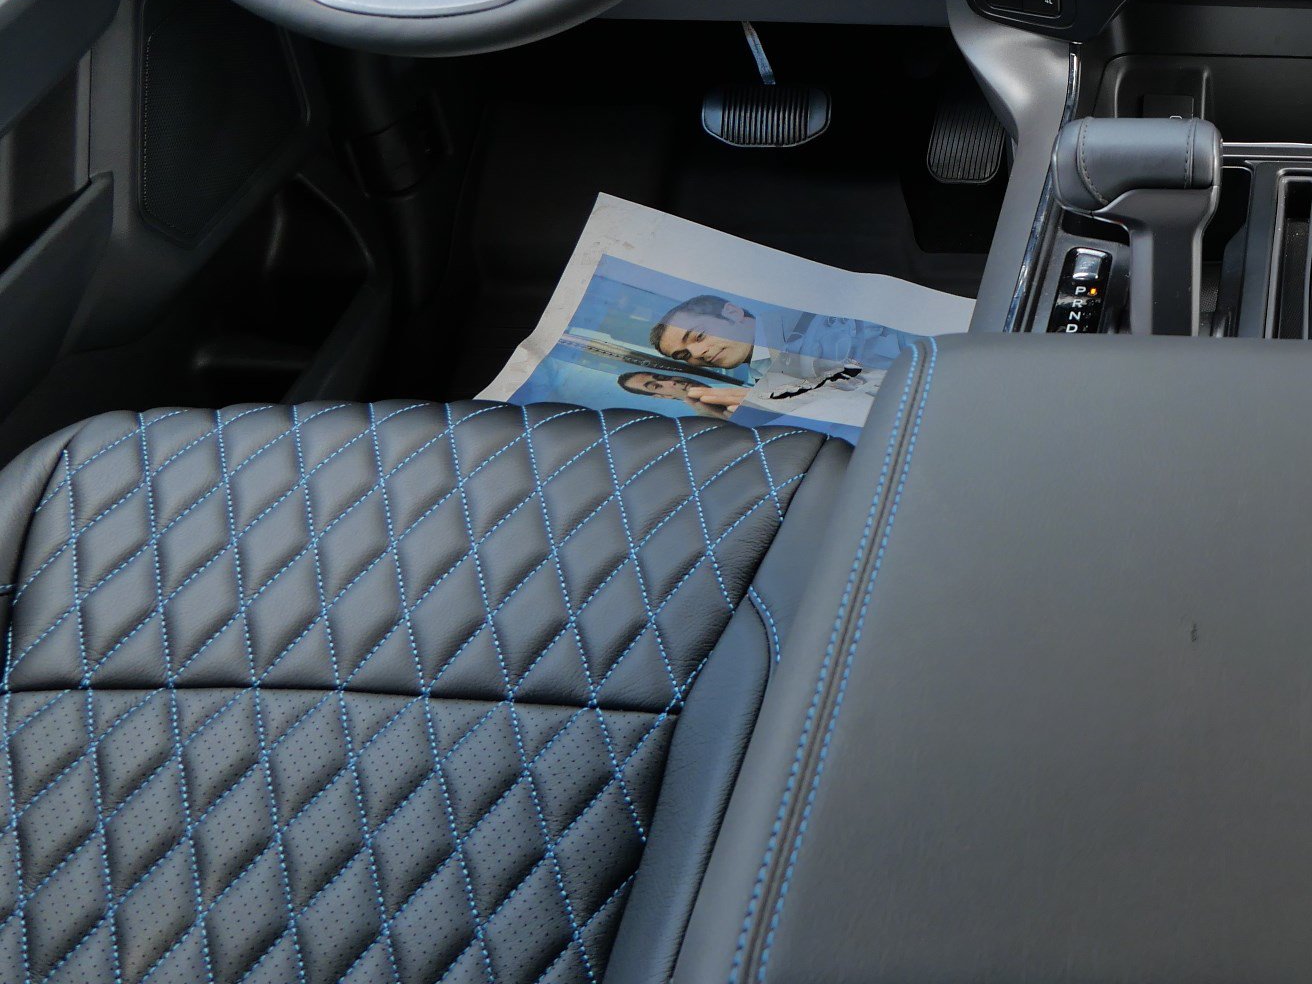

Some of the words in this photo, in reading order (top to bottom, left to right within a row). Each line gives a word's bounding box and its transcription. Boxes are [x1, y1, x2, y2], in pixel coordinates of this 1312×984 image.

[1074, 286, 1087, 295] P
[1072, 299, 1083, 308] R
[1068, 311, 1081, 320] N
[1065, 323, 1078, 333] D
